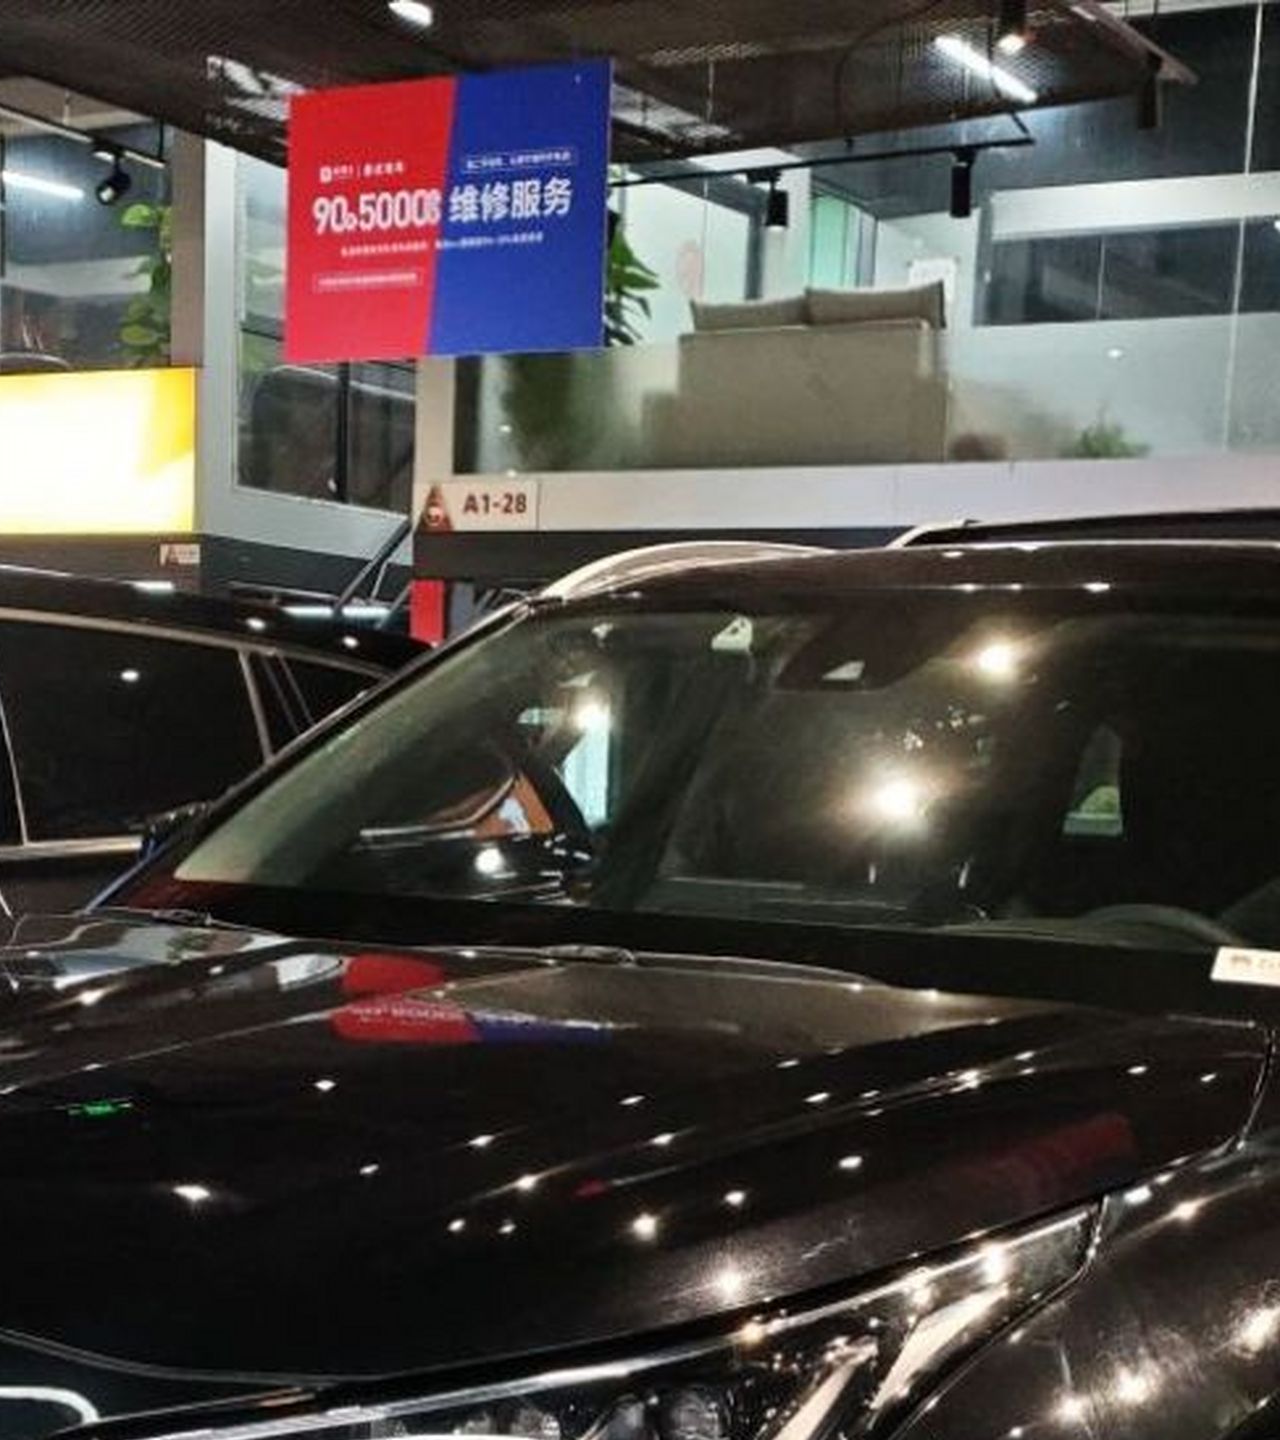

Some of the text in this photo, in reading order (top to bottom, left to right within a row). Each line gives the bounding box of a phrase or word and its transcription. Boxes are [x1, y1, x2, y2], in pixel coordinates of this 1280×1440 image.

[448, 177, 572, 223] 维修服务
[463, 493, 527, 514] A1-28
